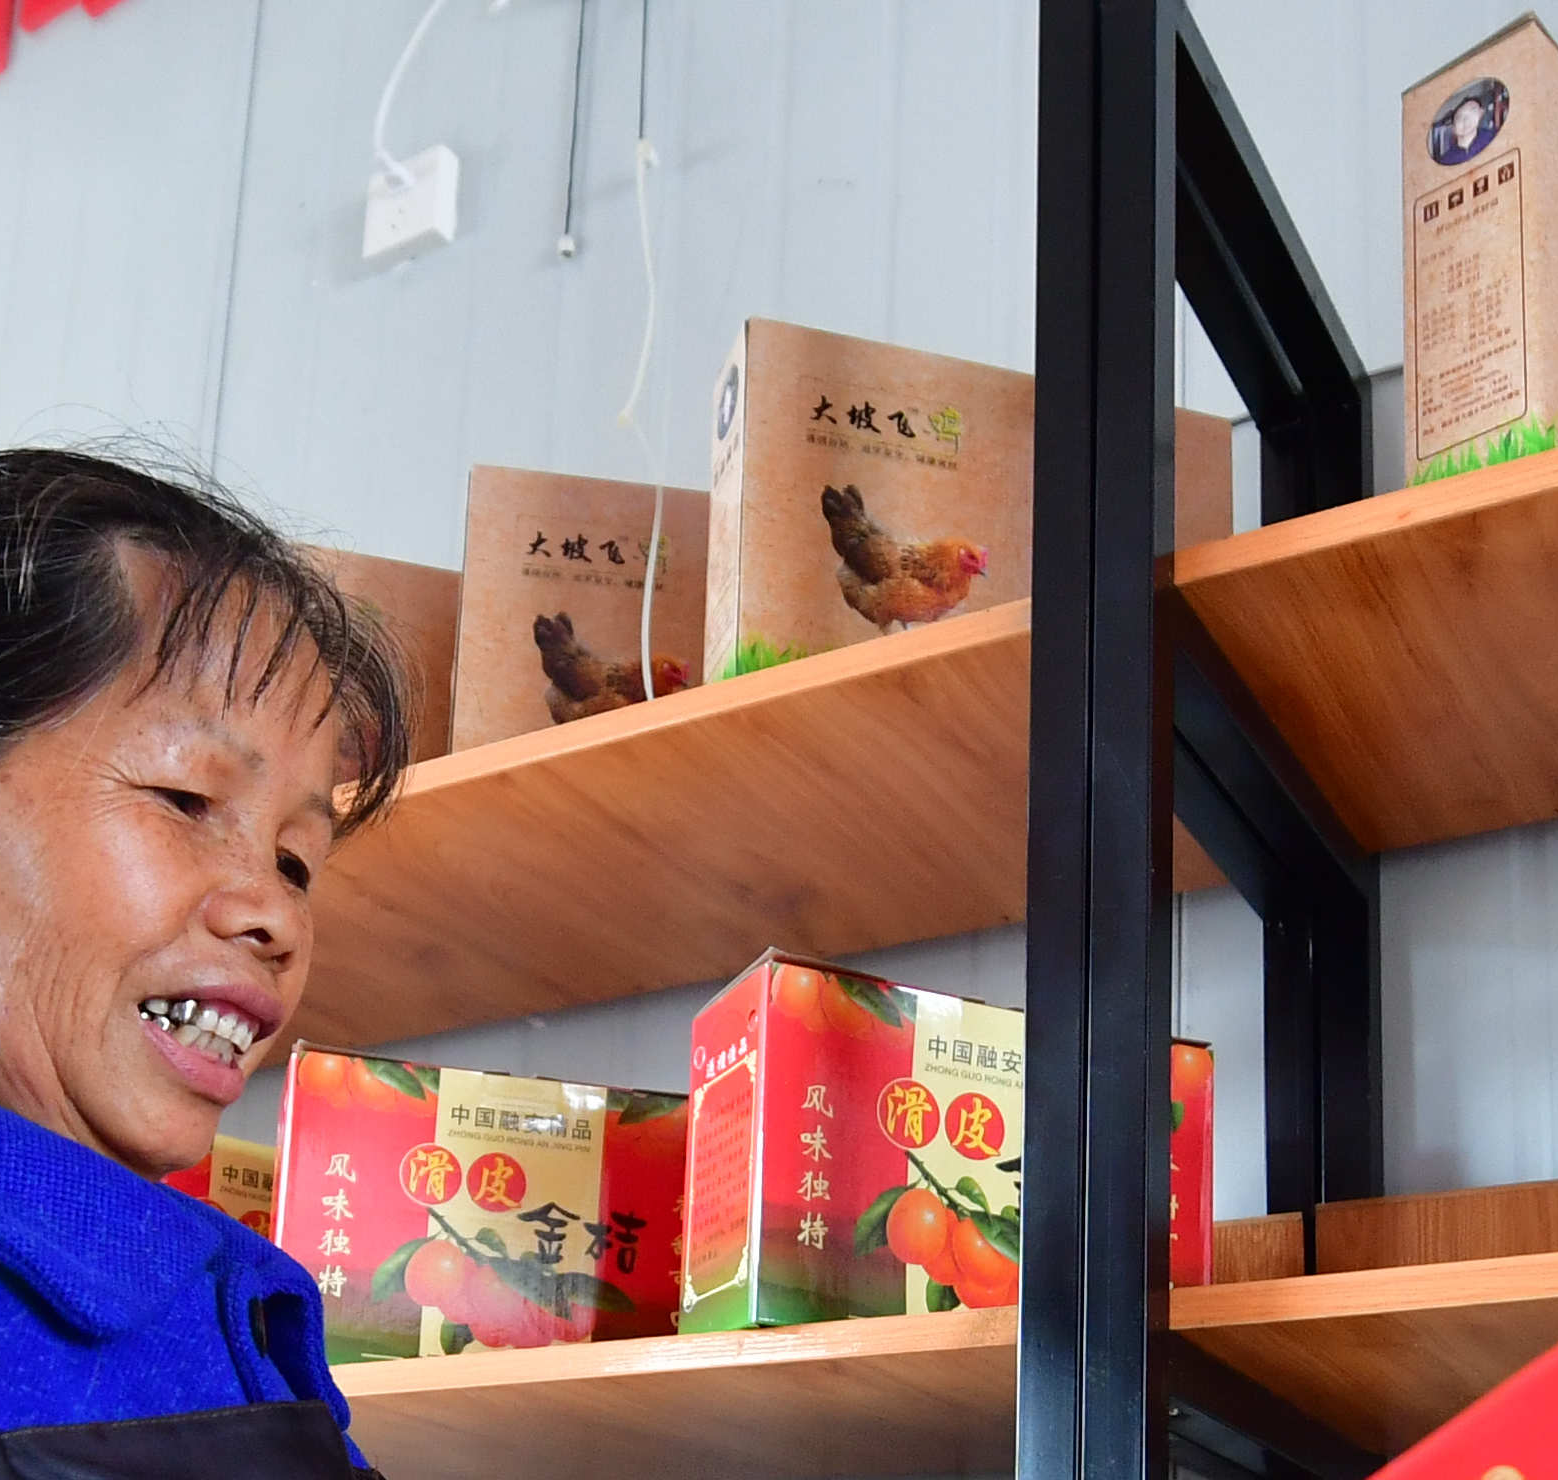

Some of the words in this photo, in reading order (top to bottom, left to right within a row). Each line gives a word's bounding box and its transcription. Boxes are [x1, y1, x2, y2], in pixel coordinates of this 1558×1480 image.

[925, 1064, 960, 1079] ZHONG
[961, 1069, 984, 1083] GUO
[984, 1074, 1014, 1088] RONG
[928, 1034, 1022, 1076] 中国融安
[447, 1129, 482, 1142] ZHONG
[482, 1132, 506, 1144] GUO
[450, 1103, 593, 1141] 中国融安精品
[885, 1084, 1003, 1158] 滑皮
[407, 1149, 523, 1209] 滑皮
[797, 1084, 835, 1251] 风味独特
[316, 1153, 357, 1299] 风味独特
[518, 1201, 648, 1275] 金桔
